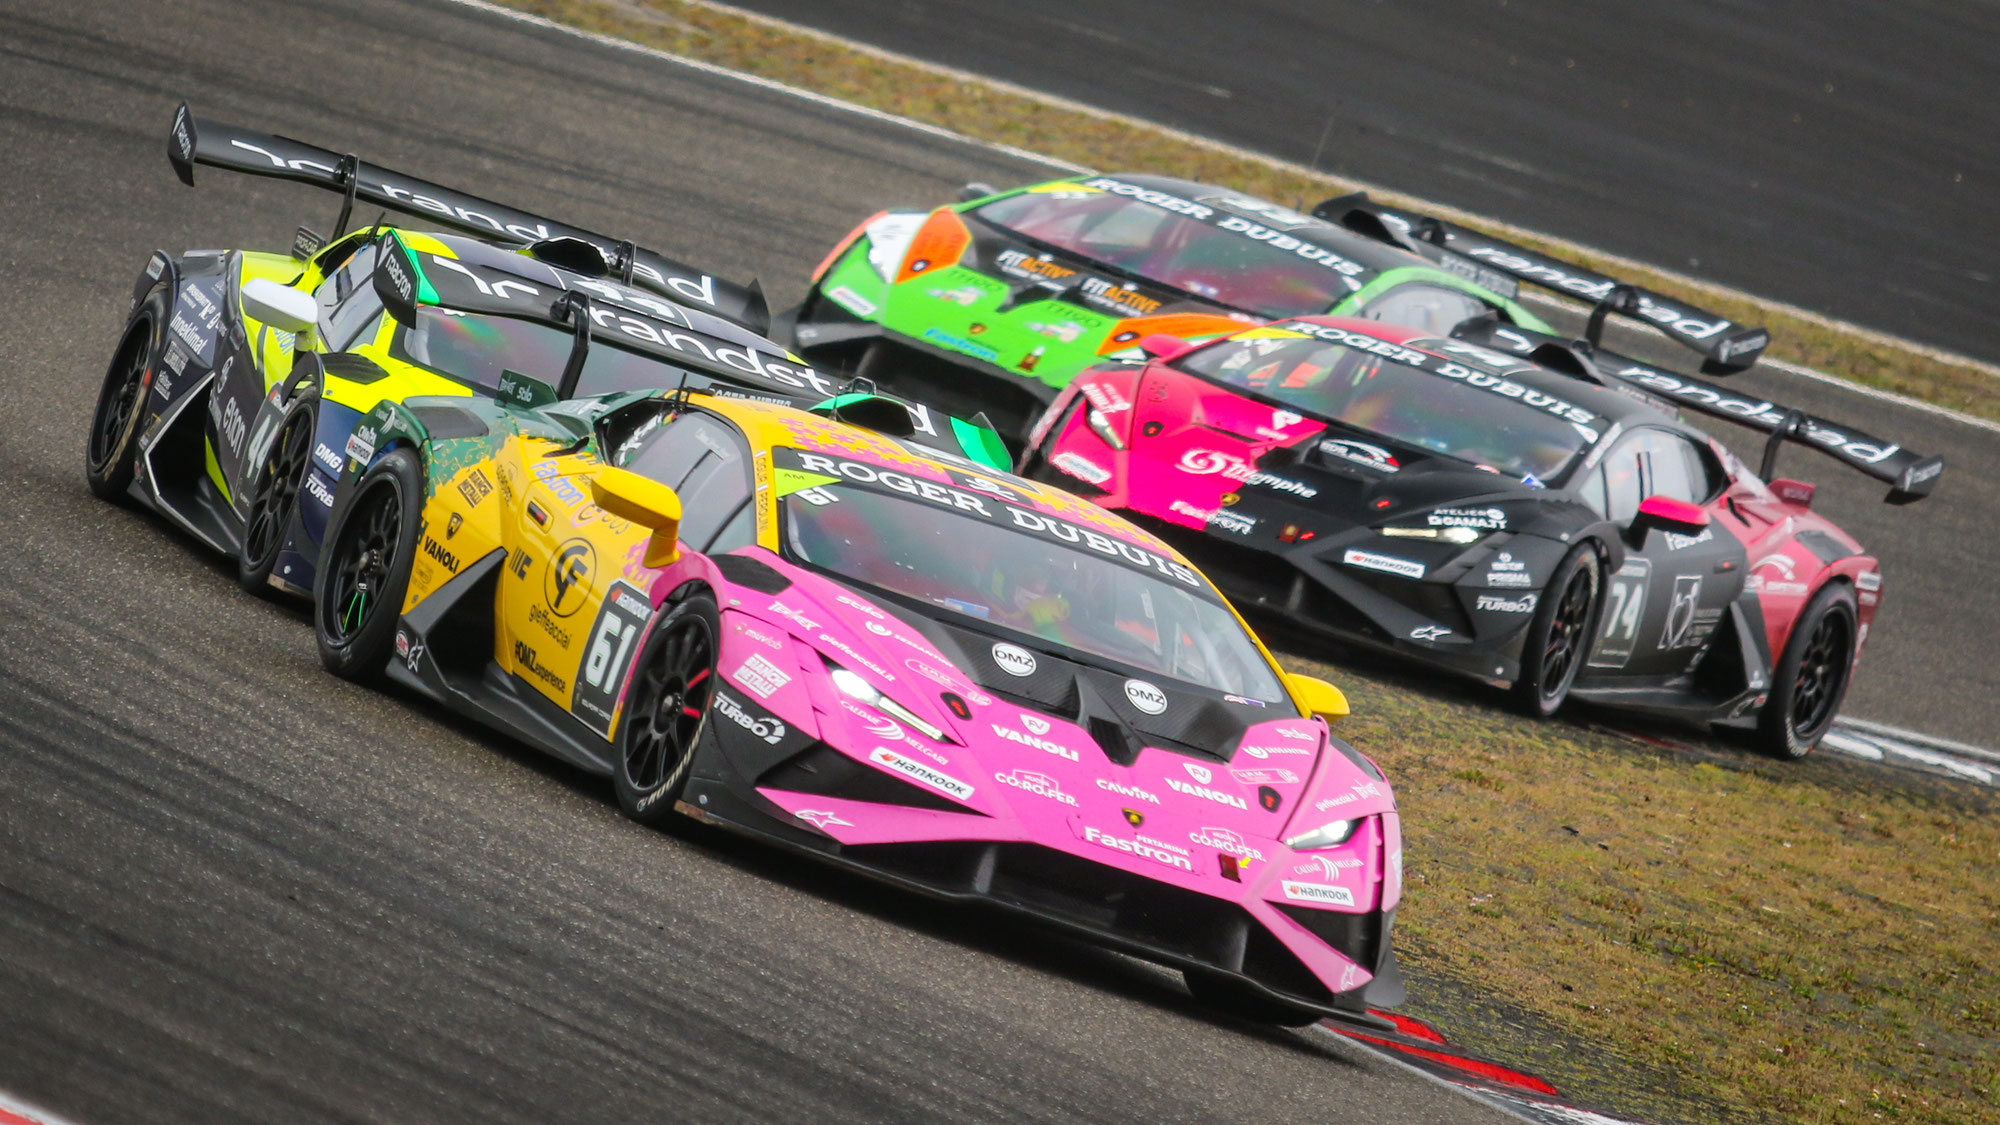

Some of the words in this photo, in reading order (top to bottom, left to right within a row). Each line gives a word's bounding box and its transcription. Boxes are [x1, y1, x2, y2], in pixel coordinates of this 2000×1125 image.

[381, 184, 715, 306] randad
[1084, 178, 1214, 220] ROGER
[1217, 215, 1365, 276] DUBUIS
[385, 253, 412, 301] macron
[1470, 246, 1731, 340] randad
[589, 305, 938, 438] randstd
[1287, 321, 1427, 366] ROGER
[1436, 361, 1596, 424] DUBUIS
[1618, 366, 1899, 464] randsad
[305, 478, 335, 508] TURB
[529, 460, 585, 508] Fastron
[783, 472, 805, 481] AM
[797, 486, 840, 506] 61
[797, 451, 992, 518] ROGER
[1006, 506, 1200, 587] DUBUIS
[424, 535, 460, 574] VANOLI
[1604, 582, 1643, 640] 74
[585, 611, 637, 695] 61
[713, 695, 769, 738] TURBO
[904, 736, 949, 766] MELGARI
[991, 724, 1080, 762] VANOLI
[1164, 777, 1248, 810] VANOLI
[1084, 826, 1193, 871] Fastron
[1136, 834, 1190, 857] PERTAMINA
